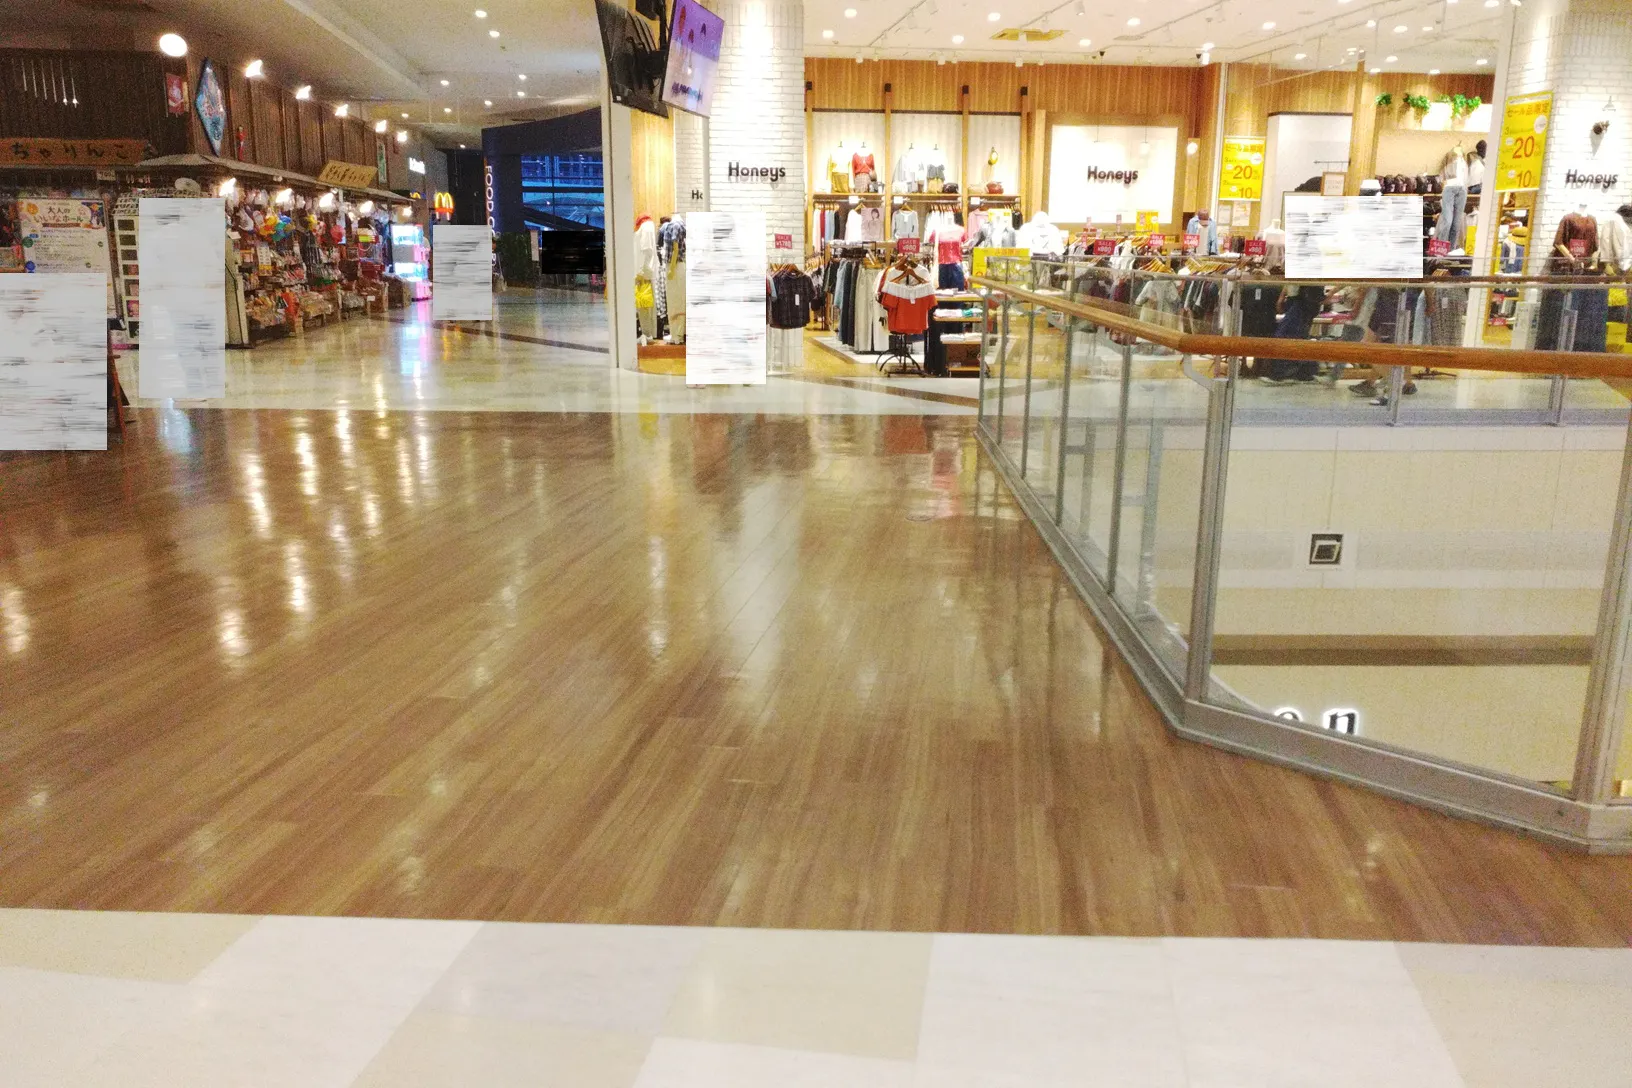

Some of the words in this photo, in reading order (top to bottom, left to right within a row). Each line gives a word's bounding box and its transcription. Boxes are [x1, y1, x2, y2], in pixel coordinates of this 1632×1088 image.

[1513, 135, 1535, 159] 20
[728, 162, 786, 182] Honeys
[1087, 165, 1138, 184] Honeys
[1233, 165, 1253, 180] 20
[1517, 170, 1532, 188] 10
[1566, 169, 1618, 189] Honeys
[485, 165, 494, 212] FOOD
[1239, 187, 1253, 199] 10
[47, 206, 71, 215] 大人の
